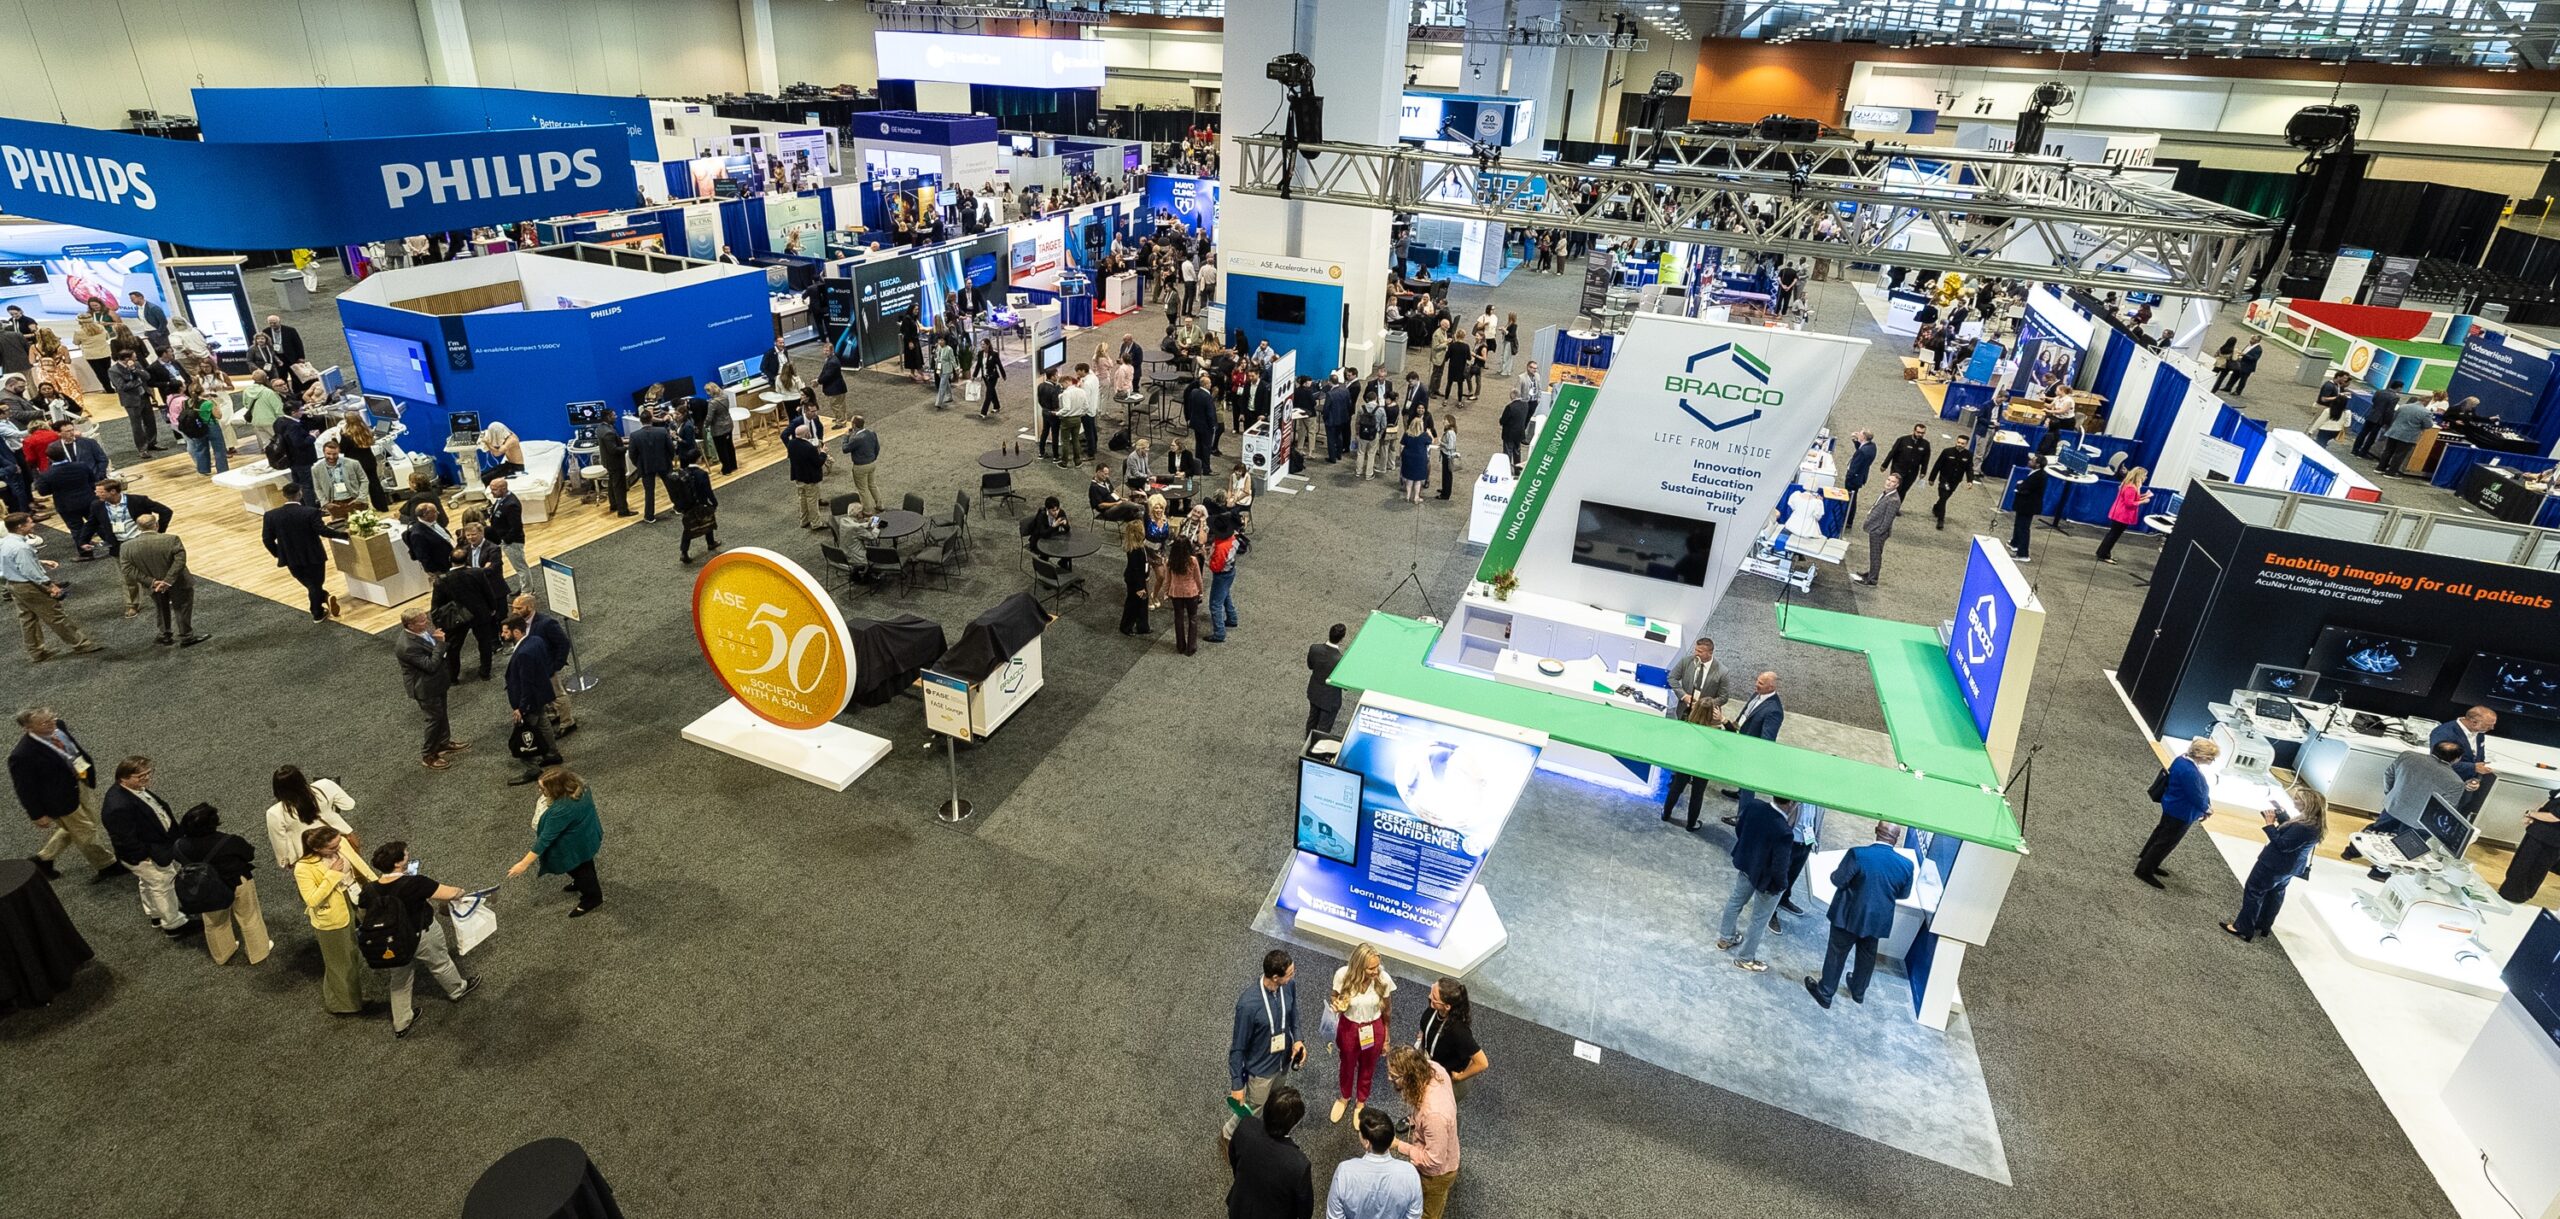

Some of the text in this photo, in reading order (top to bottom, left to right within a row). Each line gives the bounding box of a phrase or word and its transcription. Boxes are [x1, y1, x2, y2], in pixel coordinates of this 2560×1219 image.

[1484, 114, 1495, 123] 20
[2, 145, 157, 210] PHILIPS
[380, 148, 603, 209] PHILIPS
[1174, 181, 1195, 190] MAYO
[1172, 189, 1197, 197] CLINIC
[1260, 261, 1273, 269] ASE
[1274, 263, 1308, 273] Accelerator
[1310, 267, 1324, 275] Hub
[861, 294, 877, 303] visura
[590, 306, 622, 319] PHILIPS
[475, 346, 509, 354] AI-enabled
[510, 344, 536, 353] Compact
[1665, 375, 1784, 407] BRACCO
[1654, 432, 1772, 459] LIFE FROM INSIDE
[1693, 459, 1762, 479] Innovation
[1660, 481, 1746, 505] Sustainability
[1691, 472, 1754, 492] Education
[1484, 494, 1508, 504] AGFA
[1505, 477, 1543, 542] UNLOCKING
[1536, 453, 1554, 477] THE
[1706, 502, 1738, 516] Trust
[2255, 578, 2384, 606] AcuNav Lumos 4D ICE catheter
[2258, 570, 2403, 602] ACUSON Origin ultrasound system
[2264, 552, 2553, 610] Enabling imaging for all patients
[712, 588, 748, 611] ASE
[1968, 606, 1994, 659] BRACCO
[735, 602, 830, 694] 50
[750, 678, 798, 699] SOCIETY
[1000, 663, 1028, 692] BRACCO
[740, 684, 813, 715] WITH A SOUL
[931, 690, 950, 701] FASE
[930, 700, 944, 710] FASE
[944, 705, 964, 716] Lounge
[1373, 819, 1459, 851] CONFIDENCE
[1374, 810, 1460, 842] PRESCRIBE WITH
[1313, 904, 1357, 921] INVISIBLE
[1350, 885, 1448, 923] Learn more by visiting
[1369, 900, 1443, 929] LUMASON.COM
